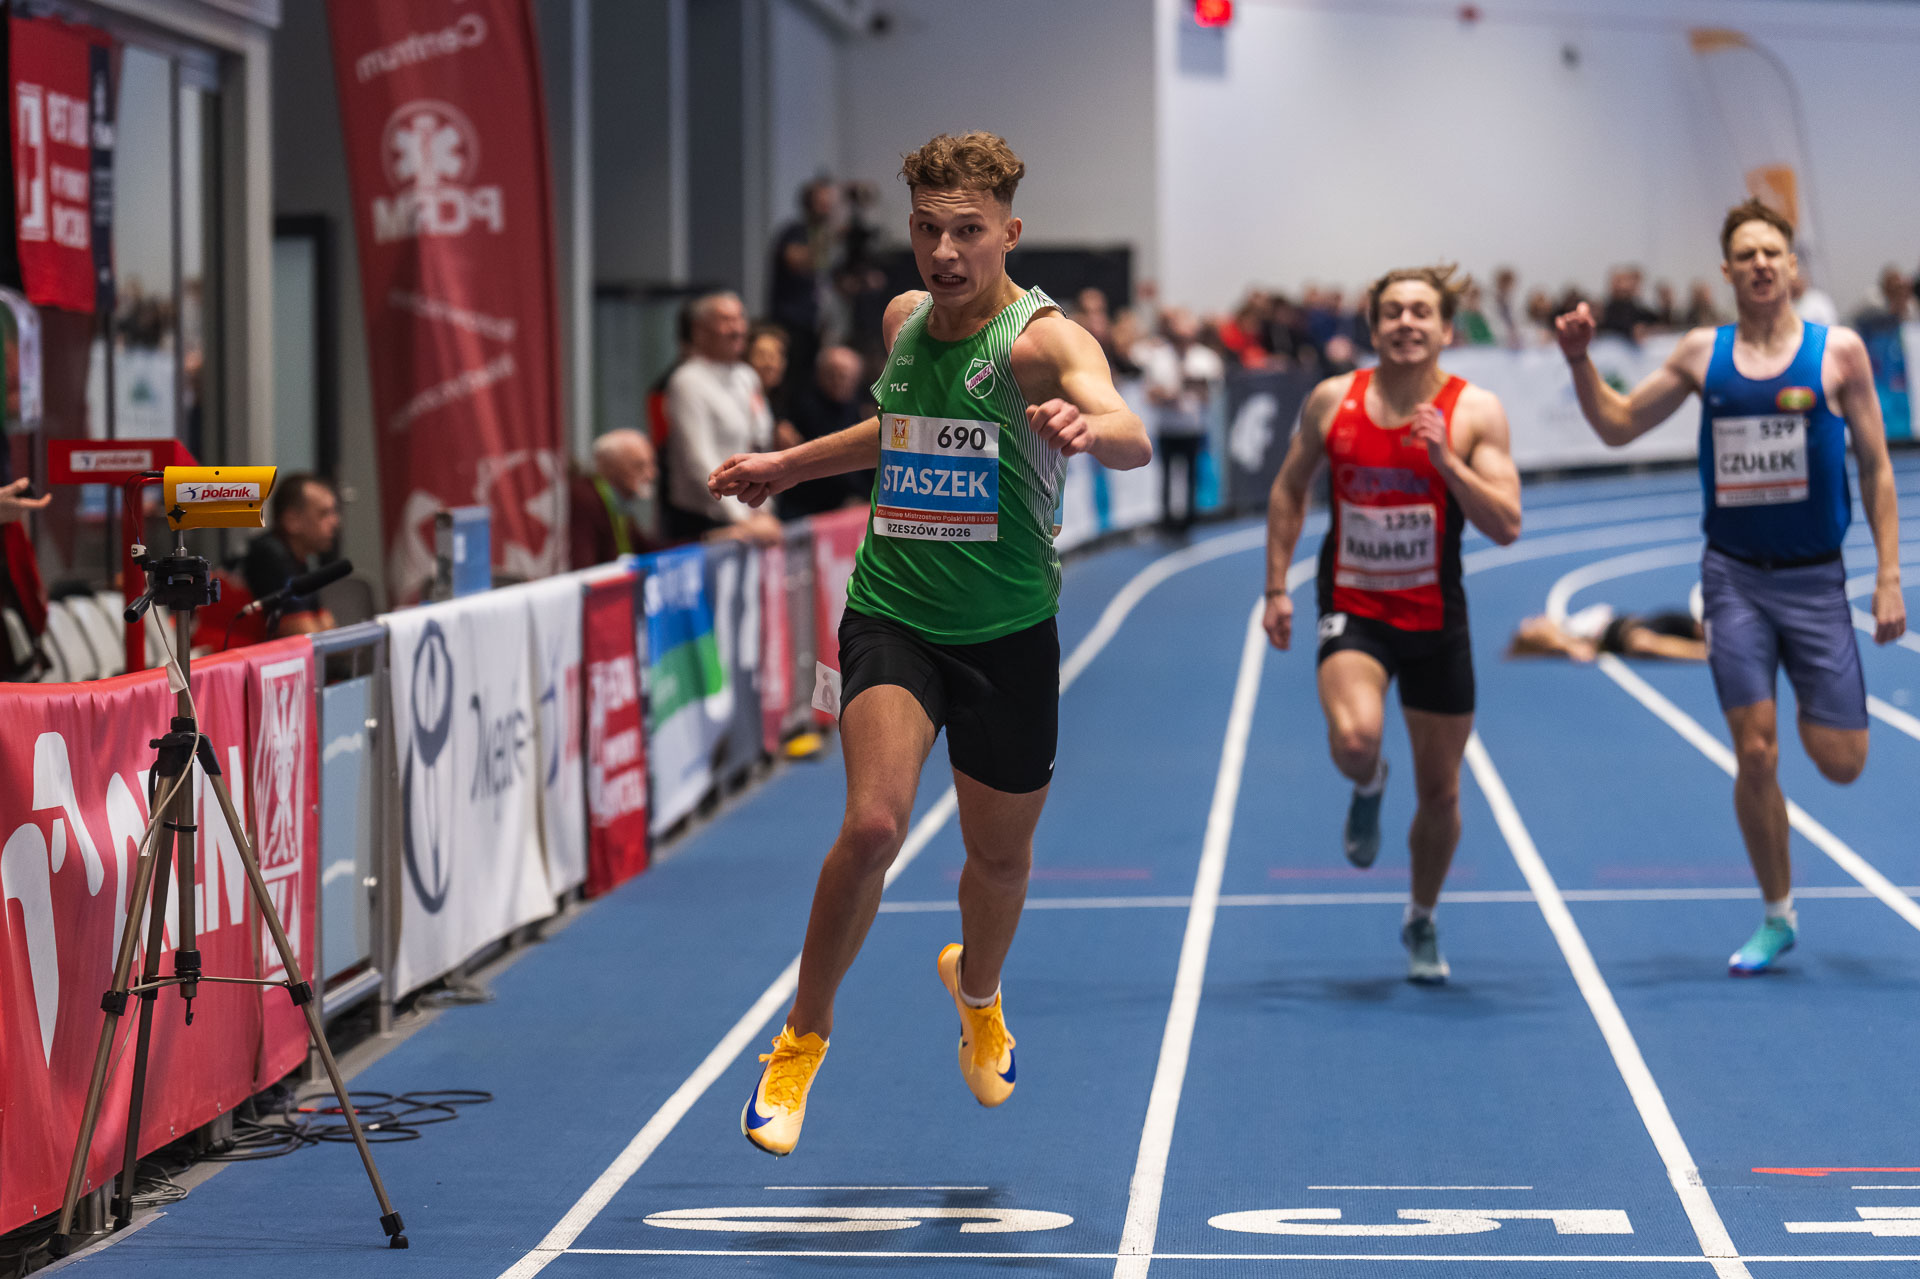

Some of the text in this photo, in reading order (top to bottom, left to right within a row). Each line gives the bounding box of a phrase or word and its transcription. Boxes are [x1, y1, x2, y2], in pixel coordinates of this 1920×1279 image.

[937, 426, 986, 450] 690
[1760, 419, 1795, 440] 529
[1719, 450, 1796, 474] CZUŁEK
[883, 465, 990, 498] STASZEK
[201, 486, 251, 500] polanik
[904, 512, 941, 520] Mistrzostwa
[888, 523, 971, 537] RZESZÓW 2026
[1207, 1208, 1634, 1236] 5
